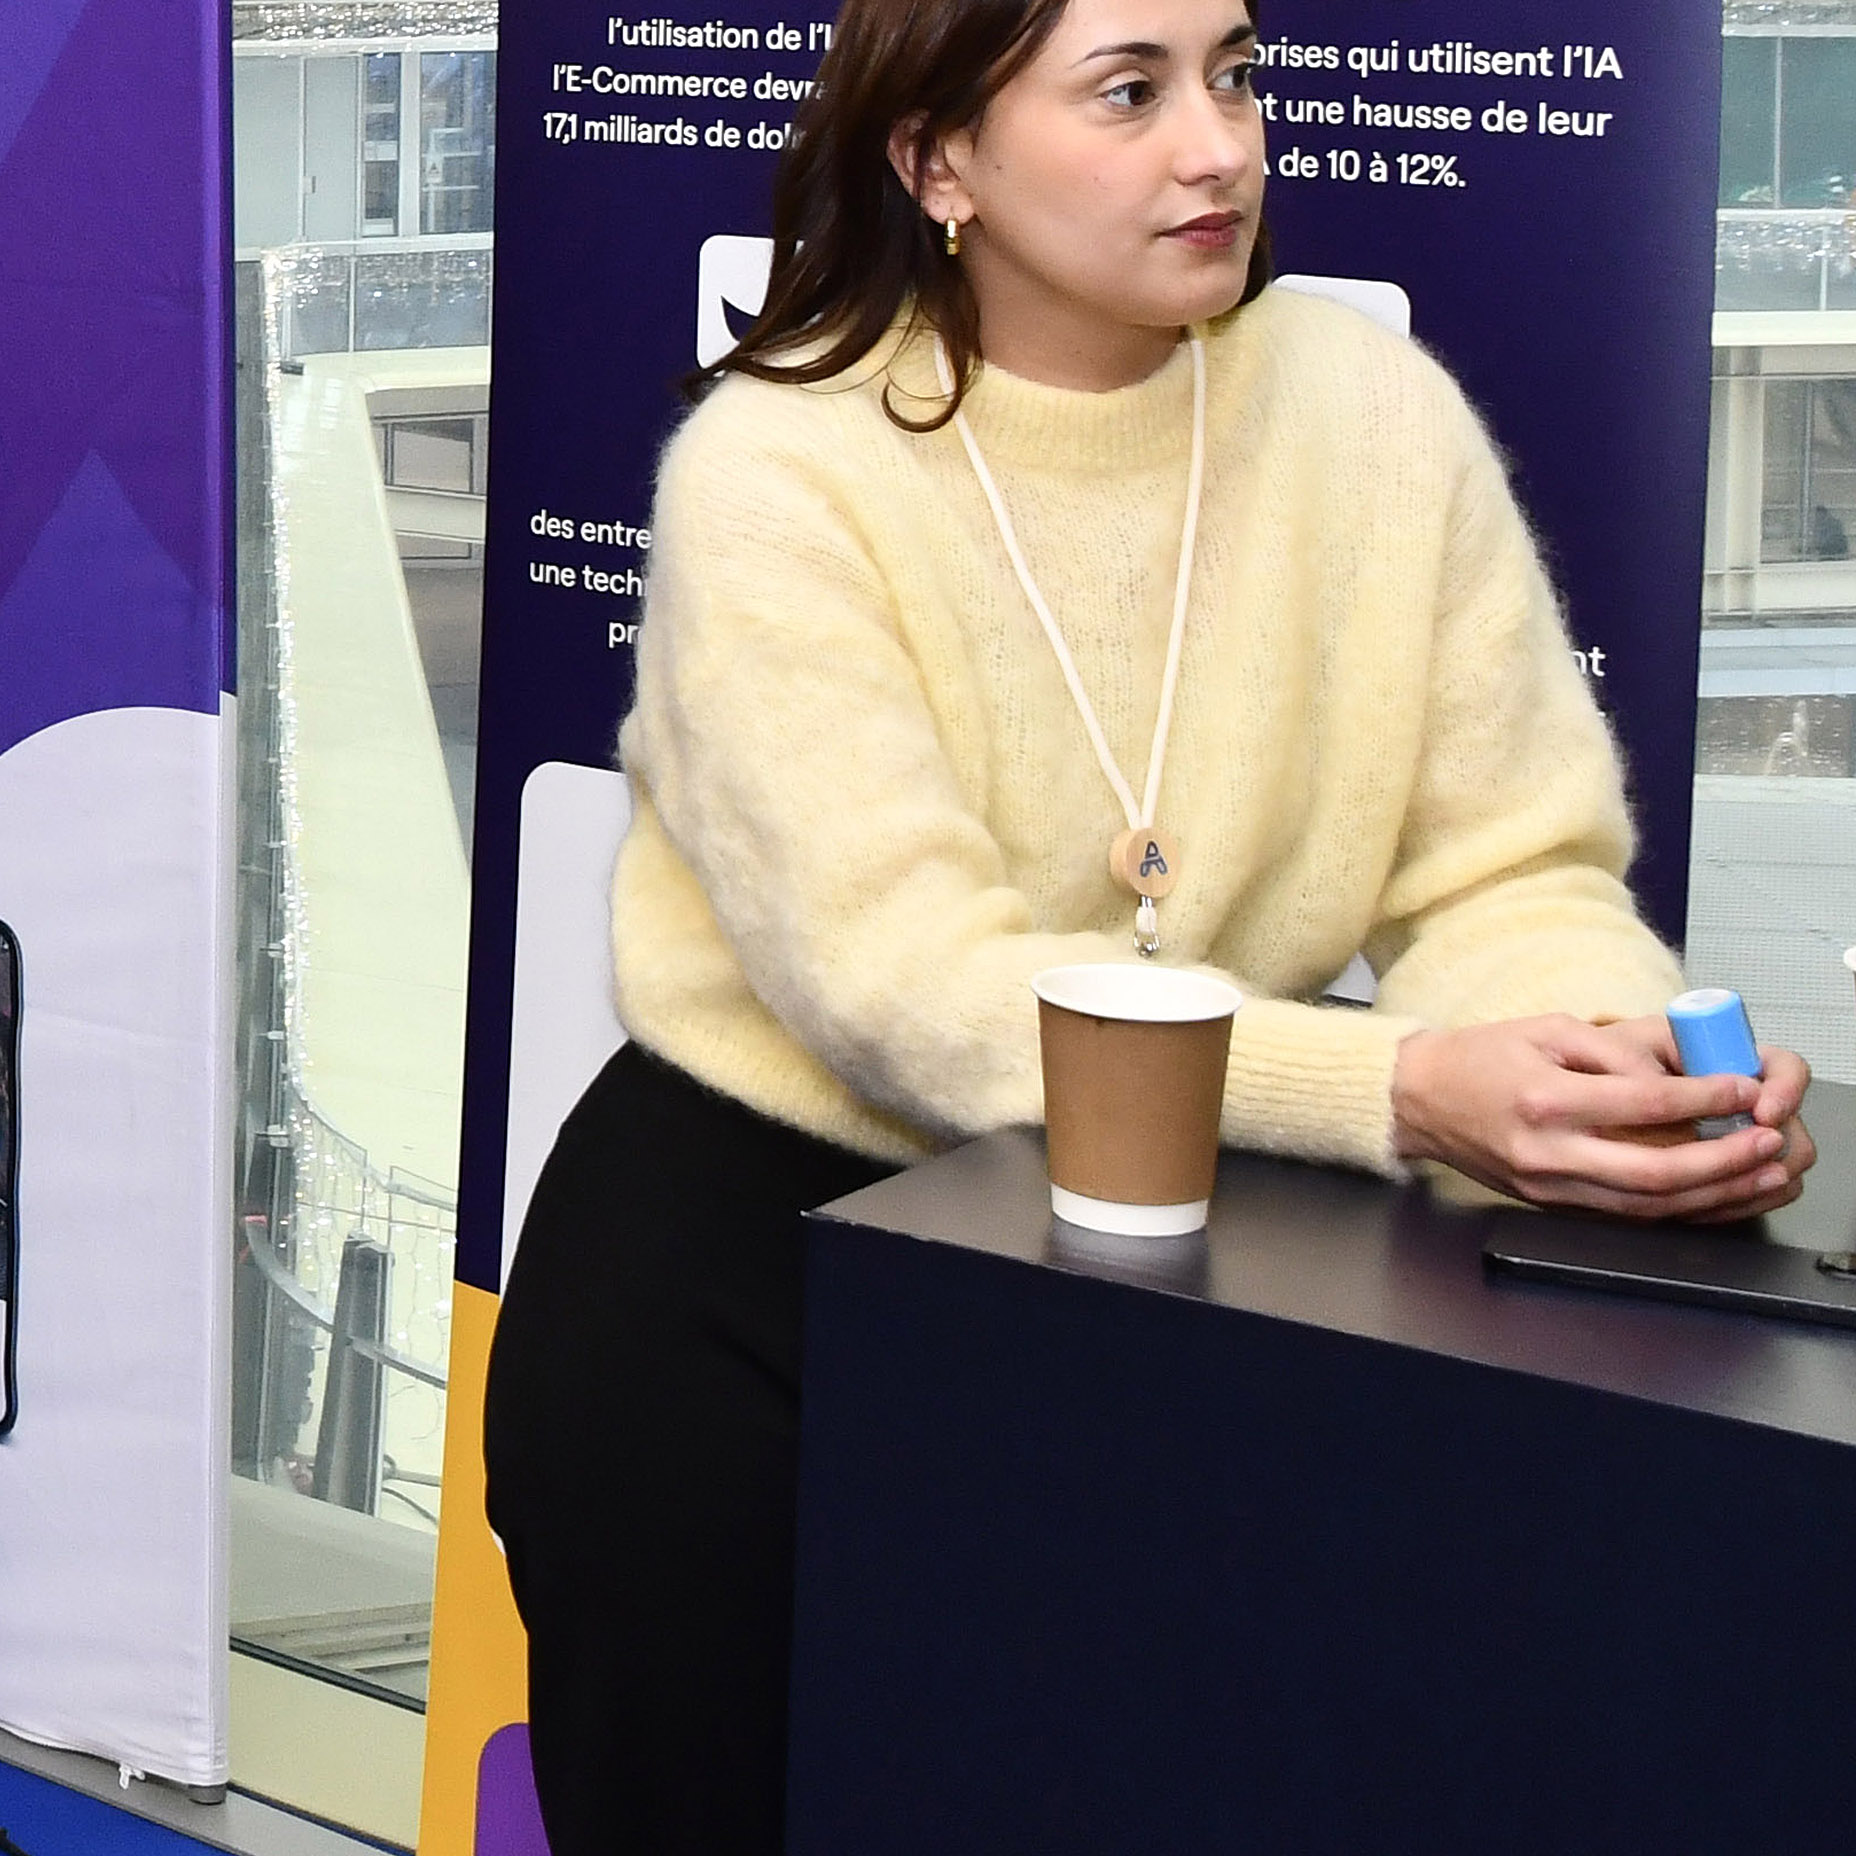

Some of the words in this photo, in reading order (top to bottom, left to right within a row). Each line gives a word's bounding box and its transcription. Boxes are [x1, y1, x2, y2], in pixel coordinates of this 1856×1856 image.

[608, 17, 759, 49] l'utilisation
[765, 21, 802, 51] de
[1347, 39, 1399, 78] qui
[1408, 41, 1554, 77] utilisent
[553, 64, 747, 99] l'E-Commerce
[543, 112, 577, 145] 17,1
[584, 114, 698, 146] milliards
[704, 119, 741, 148] de
[1285, 99, 1345, 125] une
[1353, 94, 1472, 131] hausse
[1481, 100, 1528, 133] de
[1538, 102, 1613, 137] leur
[1278, 146, 1320, 178] de
[1326, 149, 1361, 181] 10
[1369, 151, 1388, 183] à
[1396, 153, 1466, 188] 12%.
[530, 509, 575, 539] des
[581, 521, 652, 549] entre
[529, 562, 576, 588] une
